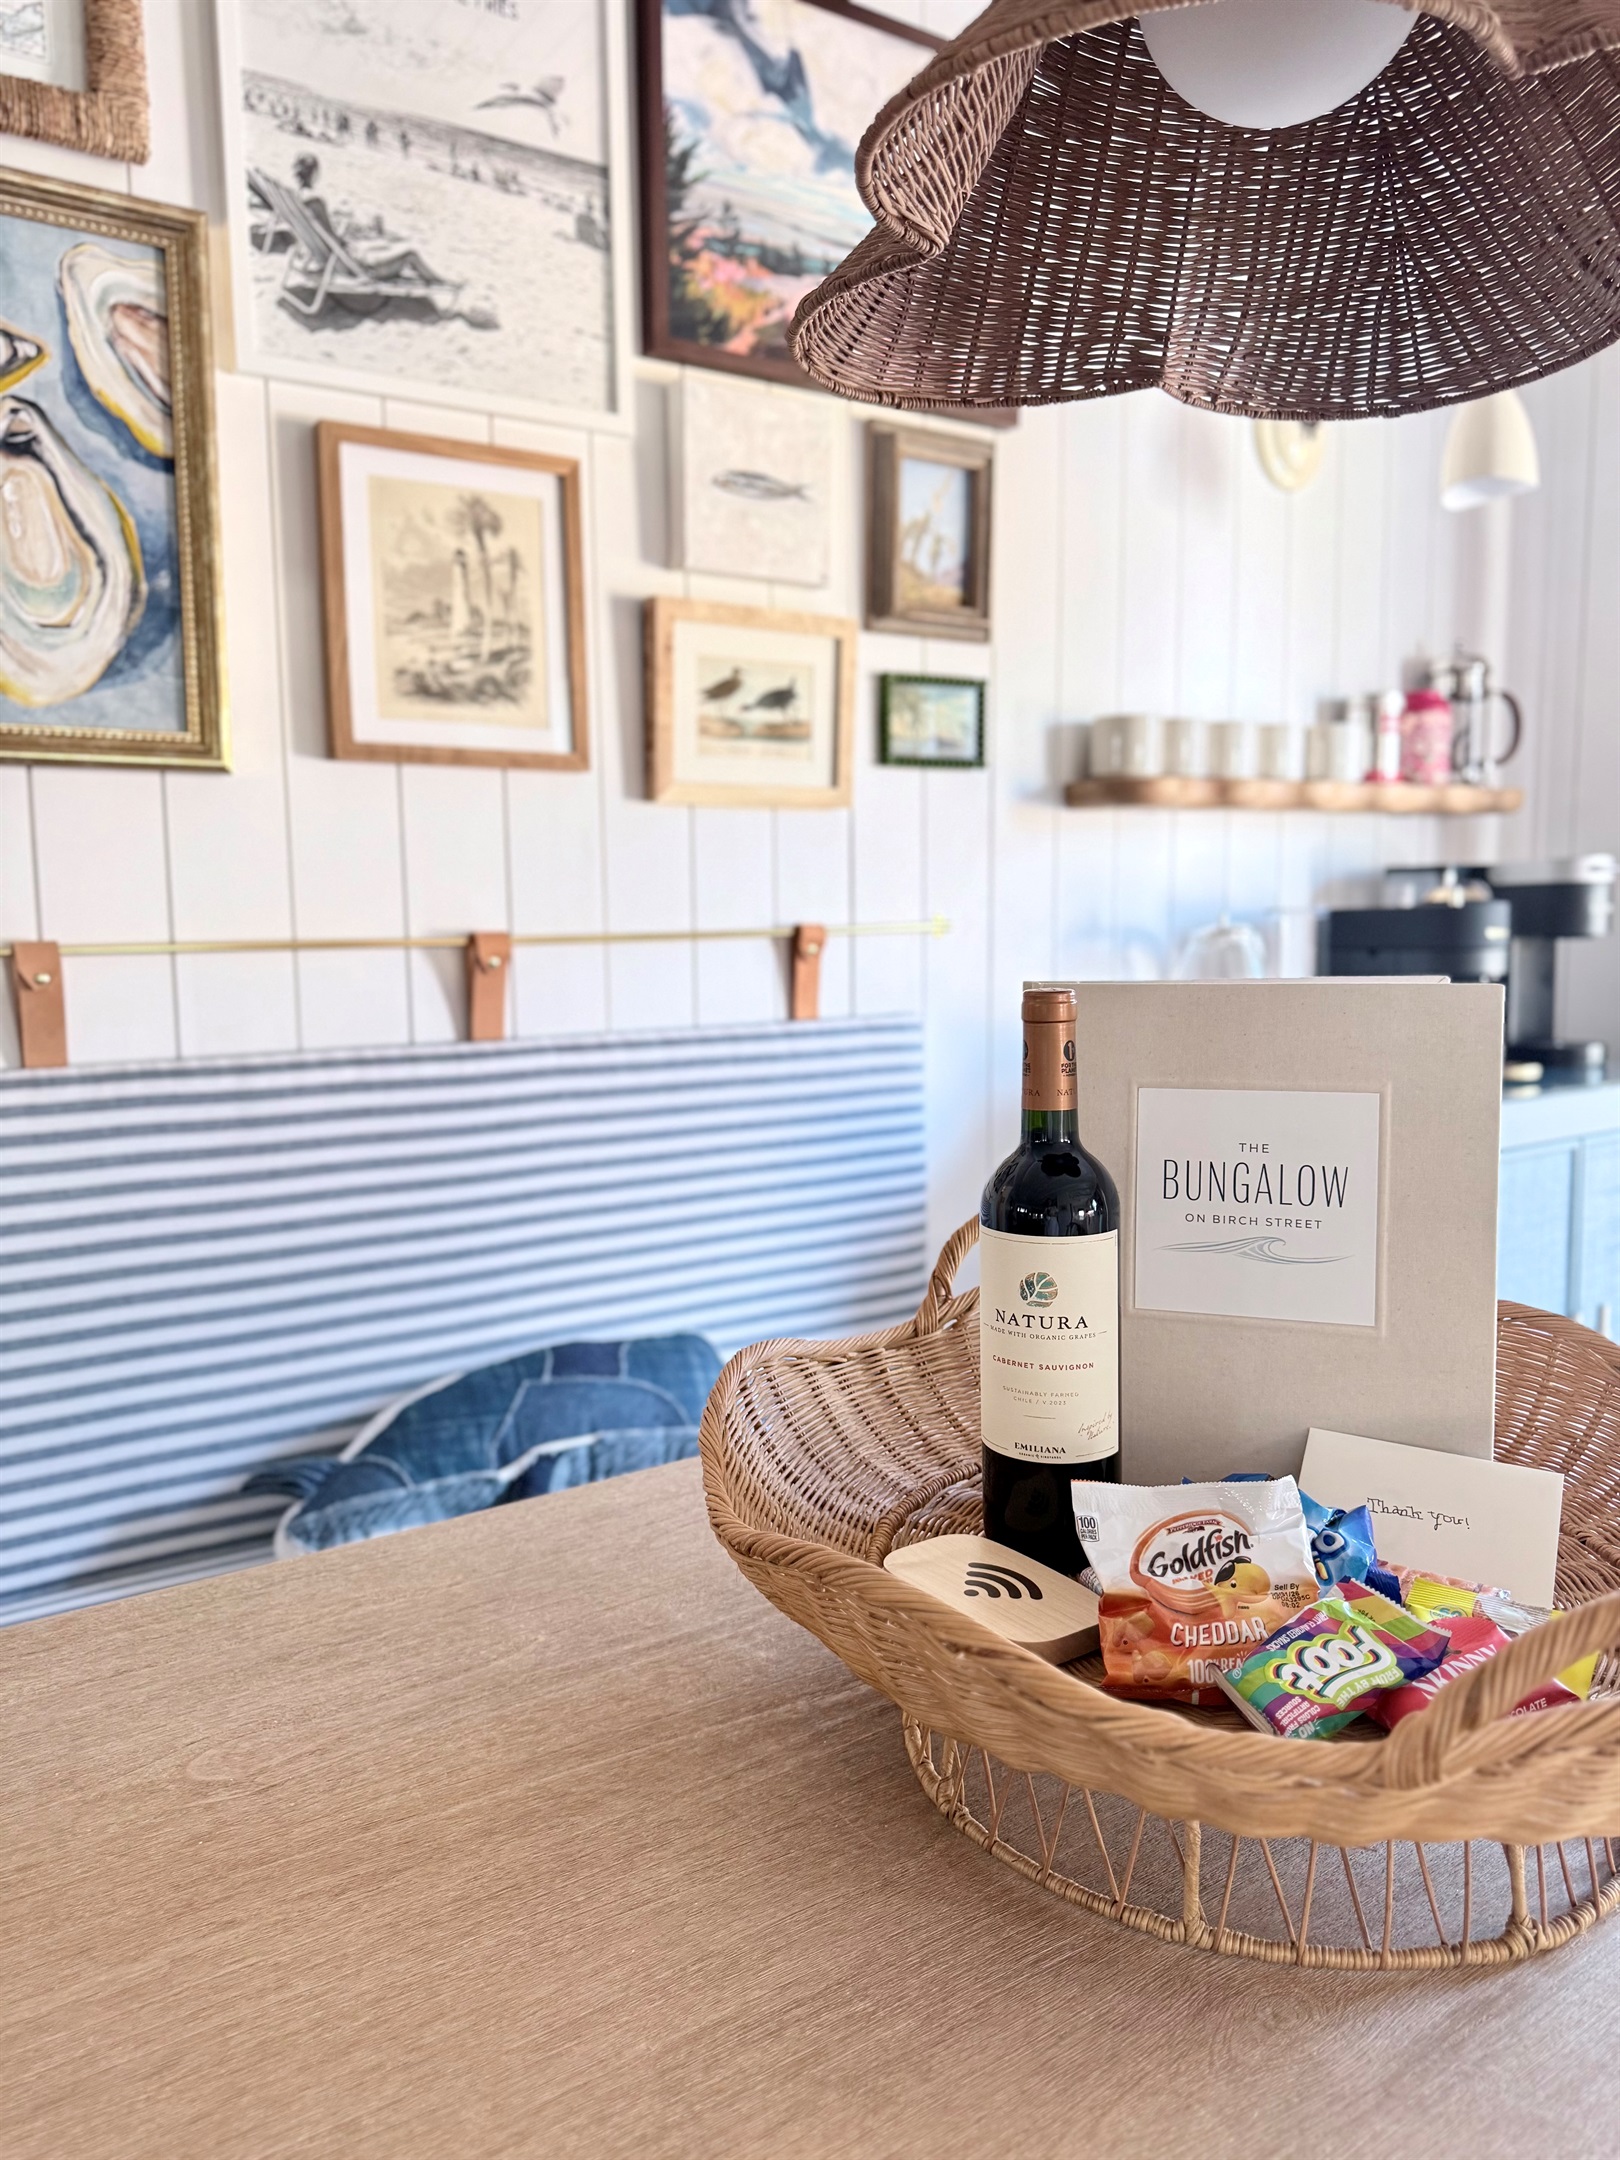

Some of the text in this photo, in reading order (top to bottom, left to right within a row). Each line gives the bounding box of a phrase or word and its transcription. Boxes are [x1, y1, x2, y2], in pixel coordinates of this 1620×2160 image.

[1238, 1142, 1270, 1154] THE
[1163, 1159, 1349, 1208] BUNGALOW
[1184, 1213, 1322, 1229] ON BIRCH STREET
[995, 1308, 1089, 1330] NATURA
[990, 1325, 1097, 1341] MADE WITH ORGANIC GRAPES
[992, 1354, 1095, 1371] CABERNET SAUVIGNON
[1002, 1385, 1047, 1398] SUSTAINABLY
[1013, 1396, 1032, 1404] CHILE
[1014, 1442, 1066, 1454] EMILIANA
[1078, 1516, 1096, 1529] 100
[1367, 1497, 1470, 1531] Thank you!
[1147, 1528, 1251, 1577] Goldfish
[1290, 1582, 1300, 1591] By
[1170, 1616, 1269, 1648] CHEDDAR
[1265, 1632, 1290, 1652] SNACKS
[1220, 1657, 1244, 1671] REA
[1281, 1626, 1392, 1699] Foot
[1355, 1679, 1369, 1692] BY
[1336, 1686, 1356, 1708] THE
[1274, 1696, 1303, 1720] SOURCES
[1279, 1700, 1311, 1727] ARTIFICIAL
[1298, 1704, 1321, 1725] COLORS
[1299, 1720, 1316, 1739] NO
